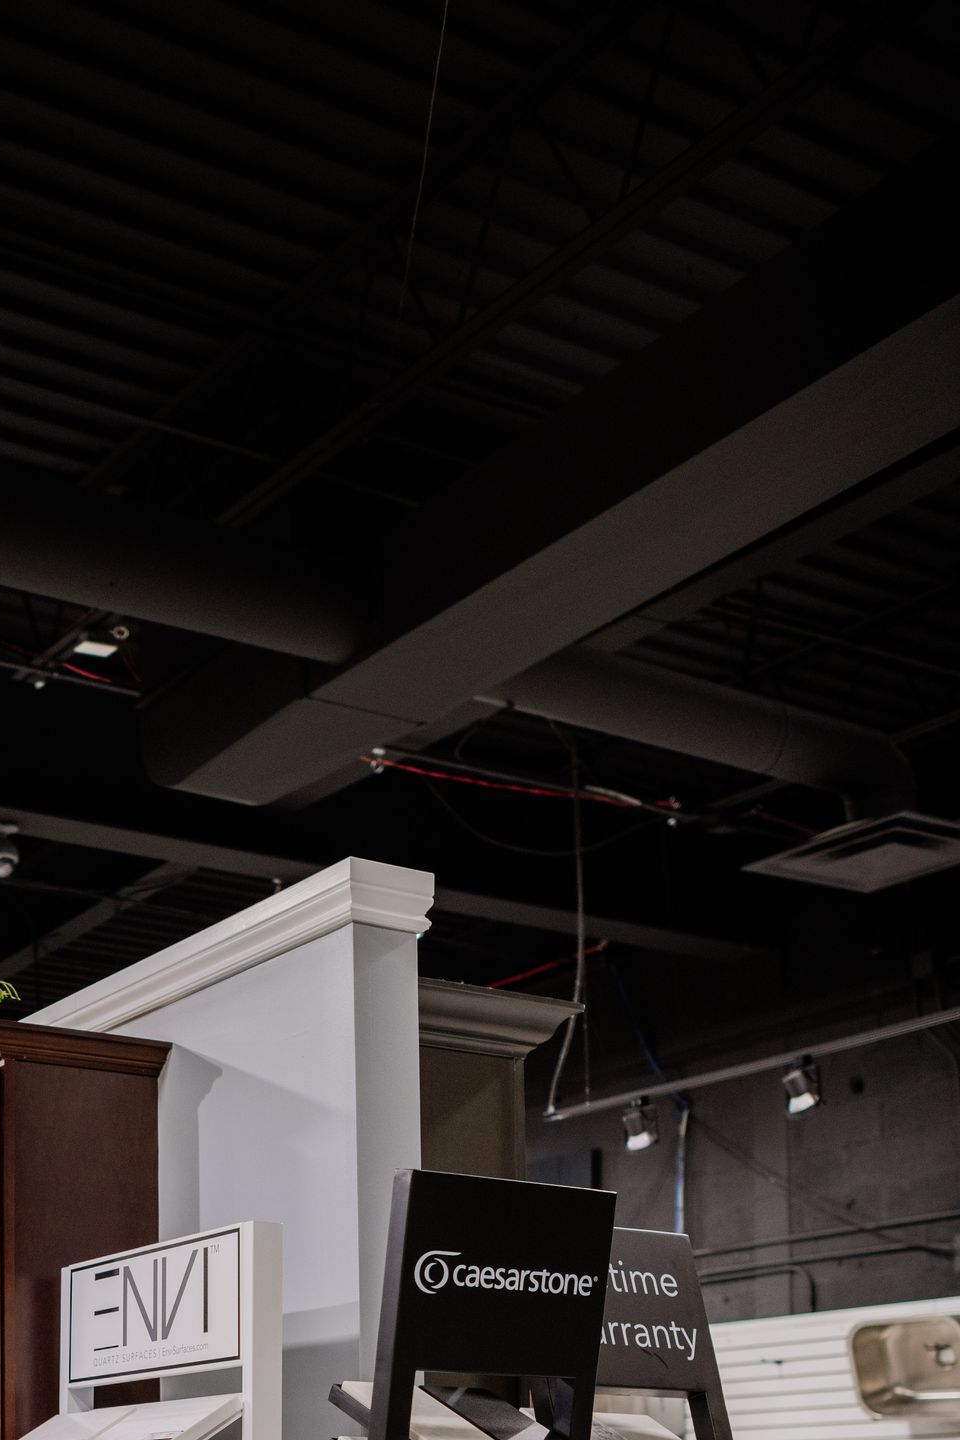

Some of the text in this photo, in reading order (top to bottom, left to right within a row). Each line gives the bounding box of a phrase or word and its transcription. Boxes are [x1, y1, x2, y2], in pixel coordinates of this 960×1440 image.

[452, 1263, 593, 1297] caesarstone
[608, 1260, 679, 1297] time
[93, 1354, 119, 1367] QUARTZ
[122, 1348, 157, 1363] SURFACES
